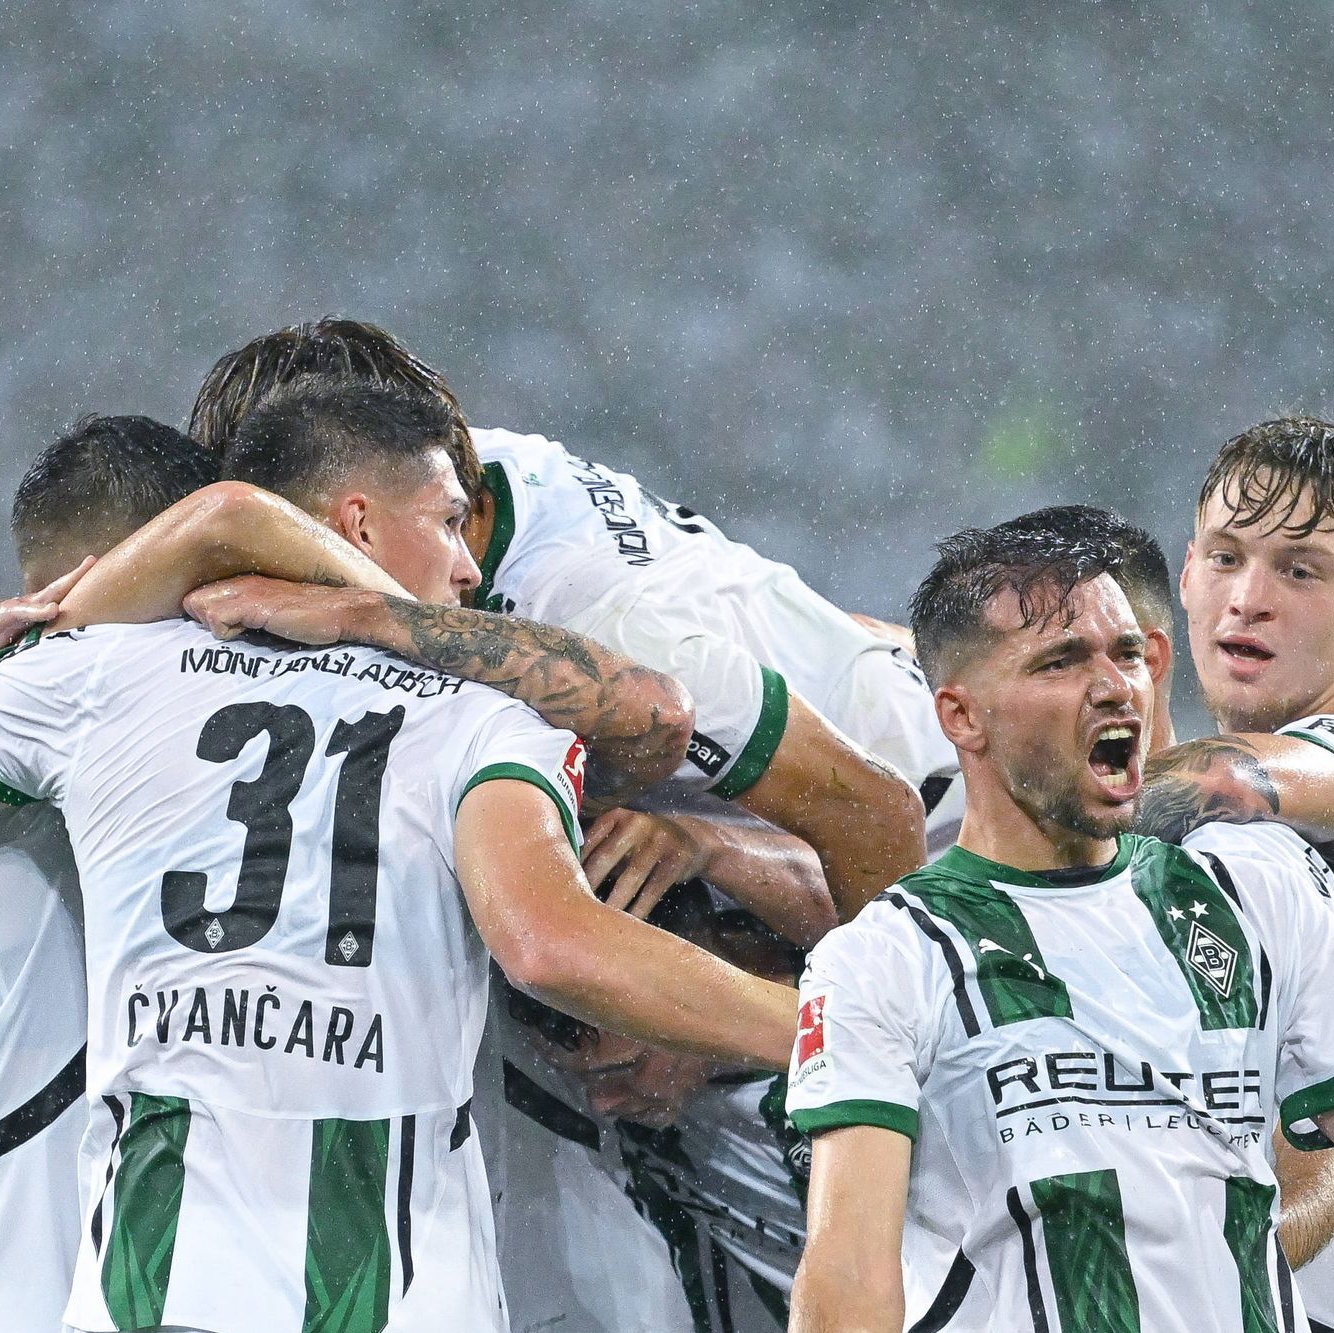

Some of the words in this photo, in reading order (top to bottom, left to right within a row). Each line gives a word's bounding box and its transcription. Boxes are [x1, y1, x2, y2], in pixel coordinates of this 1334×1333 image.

[160, 700, 407, 968] 31
[127, 984, 385, 1074] ČVANČARA
[999, 1112, 1116, 1144] BÄDER
